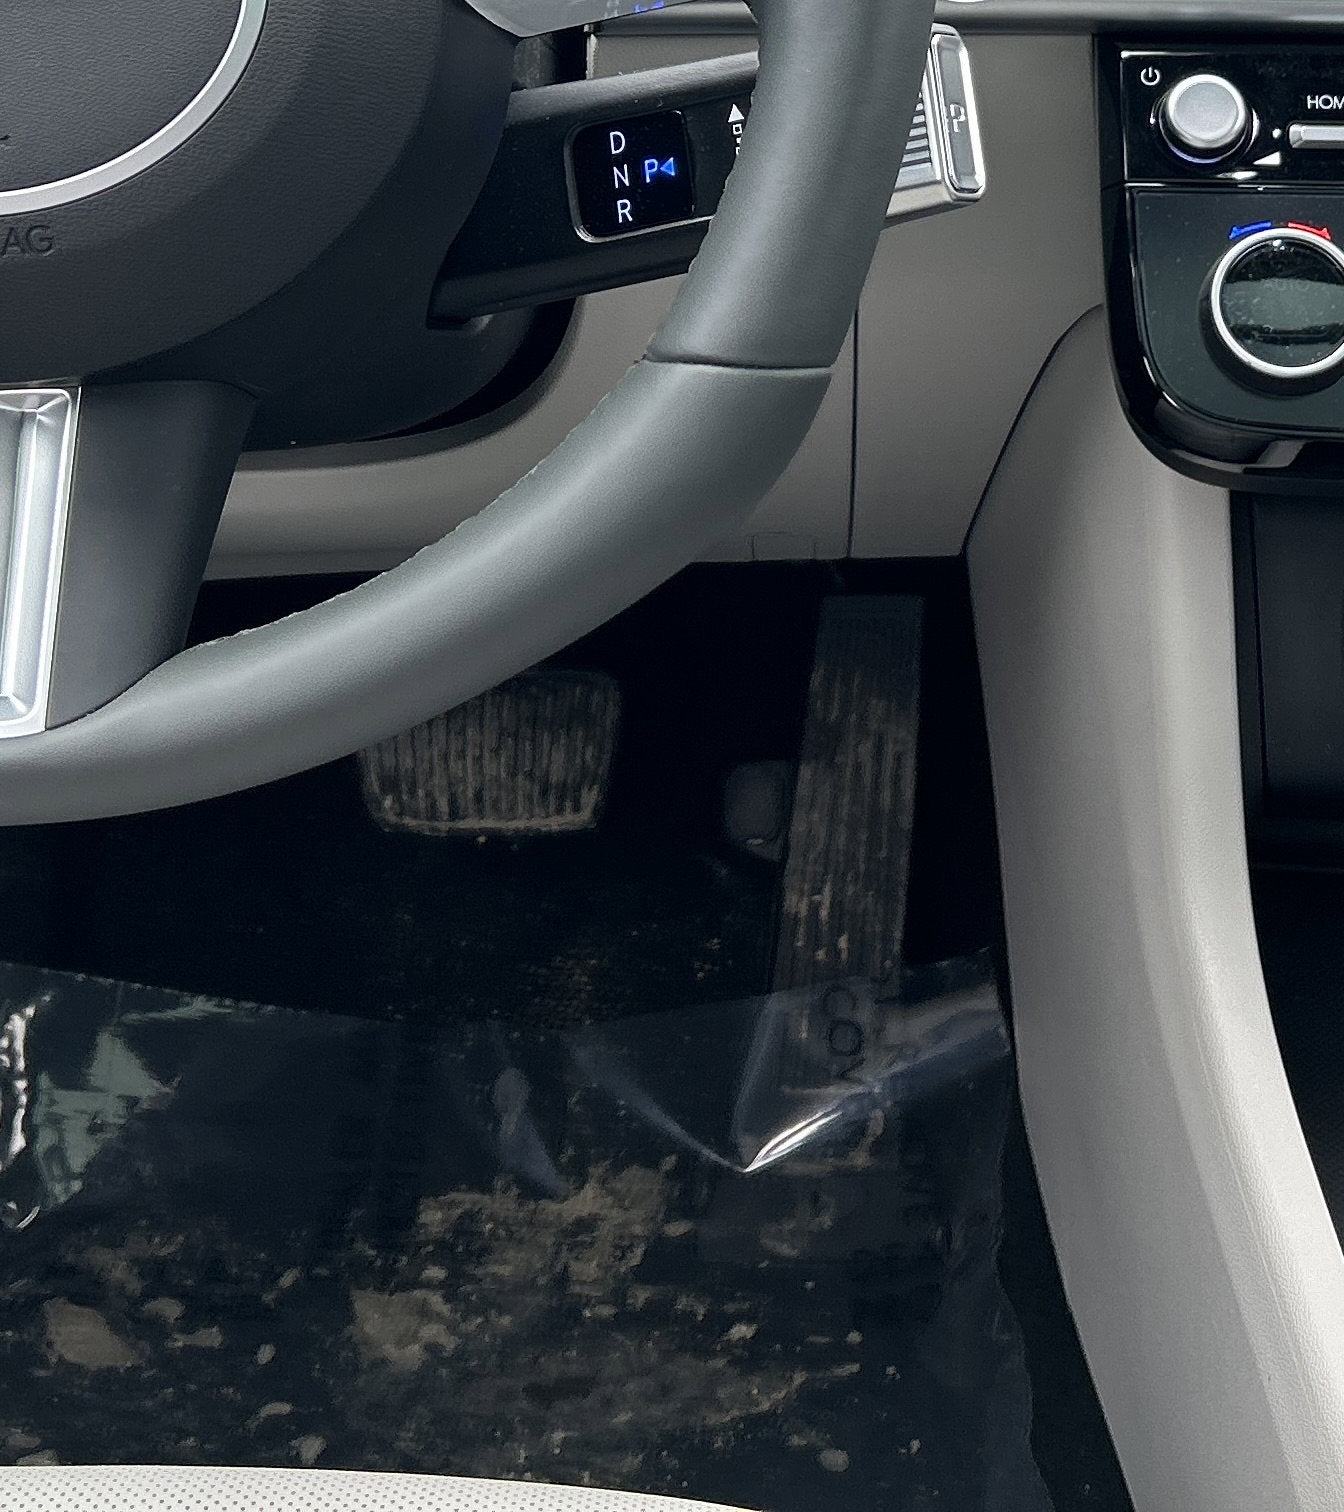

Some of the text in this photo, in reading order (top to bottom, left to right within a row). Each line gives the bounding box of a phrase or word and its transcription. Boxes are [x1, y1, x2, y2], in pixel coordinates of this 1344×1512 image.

[609, 131, 626, 155] D
[613, 158, 659, 189] N P
[616, 198, 633, 224] R
